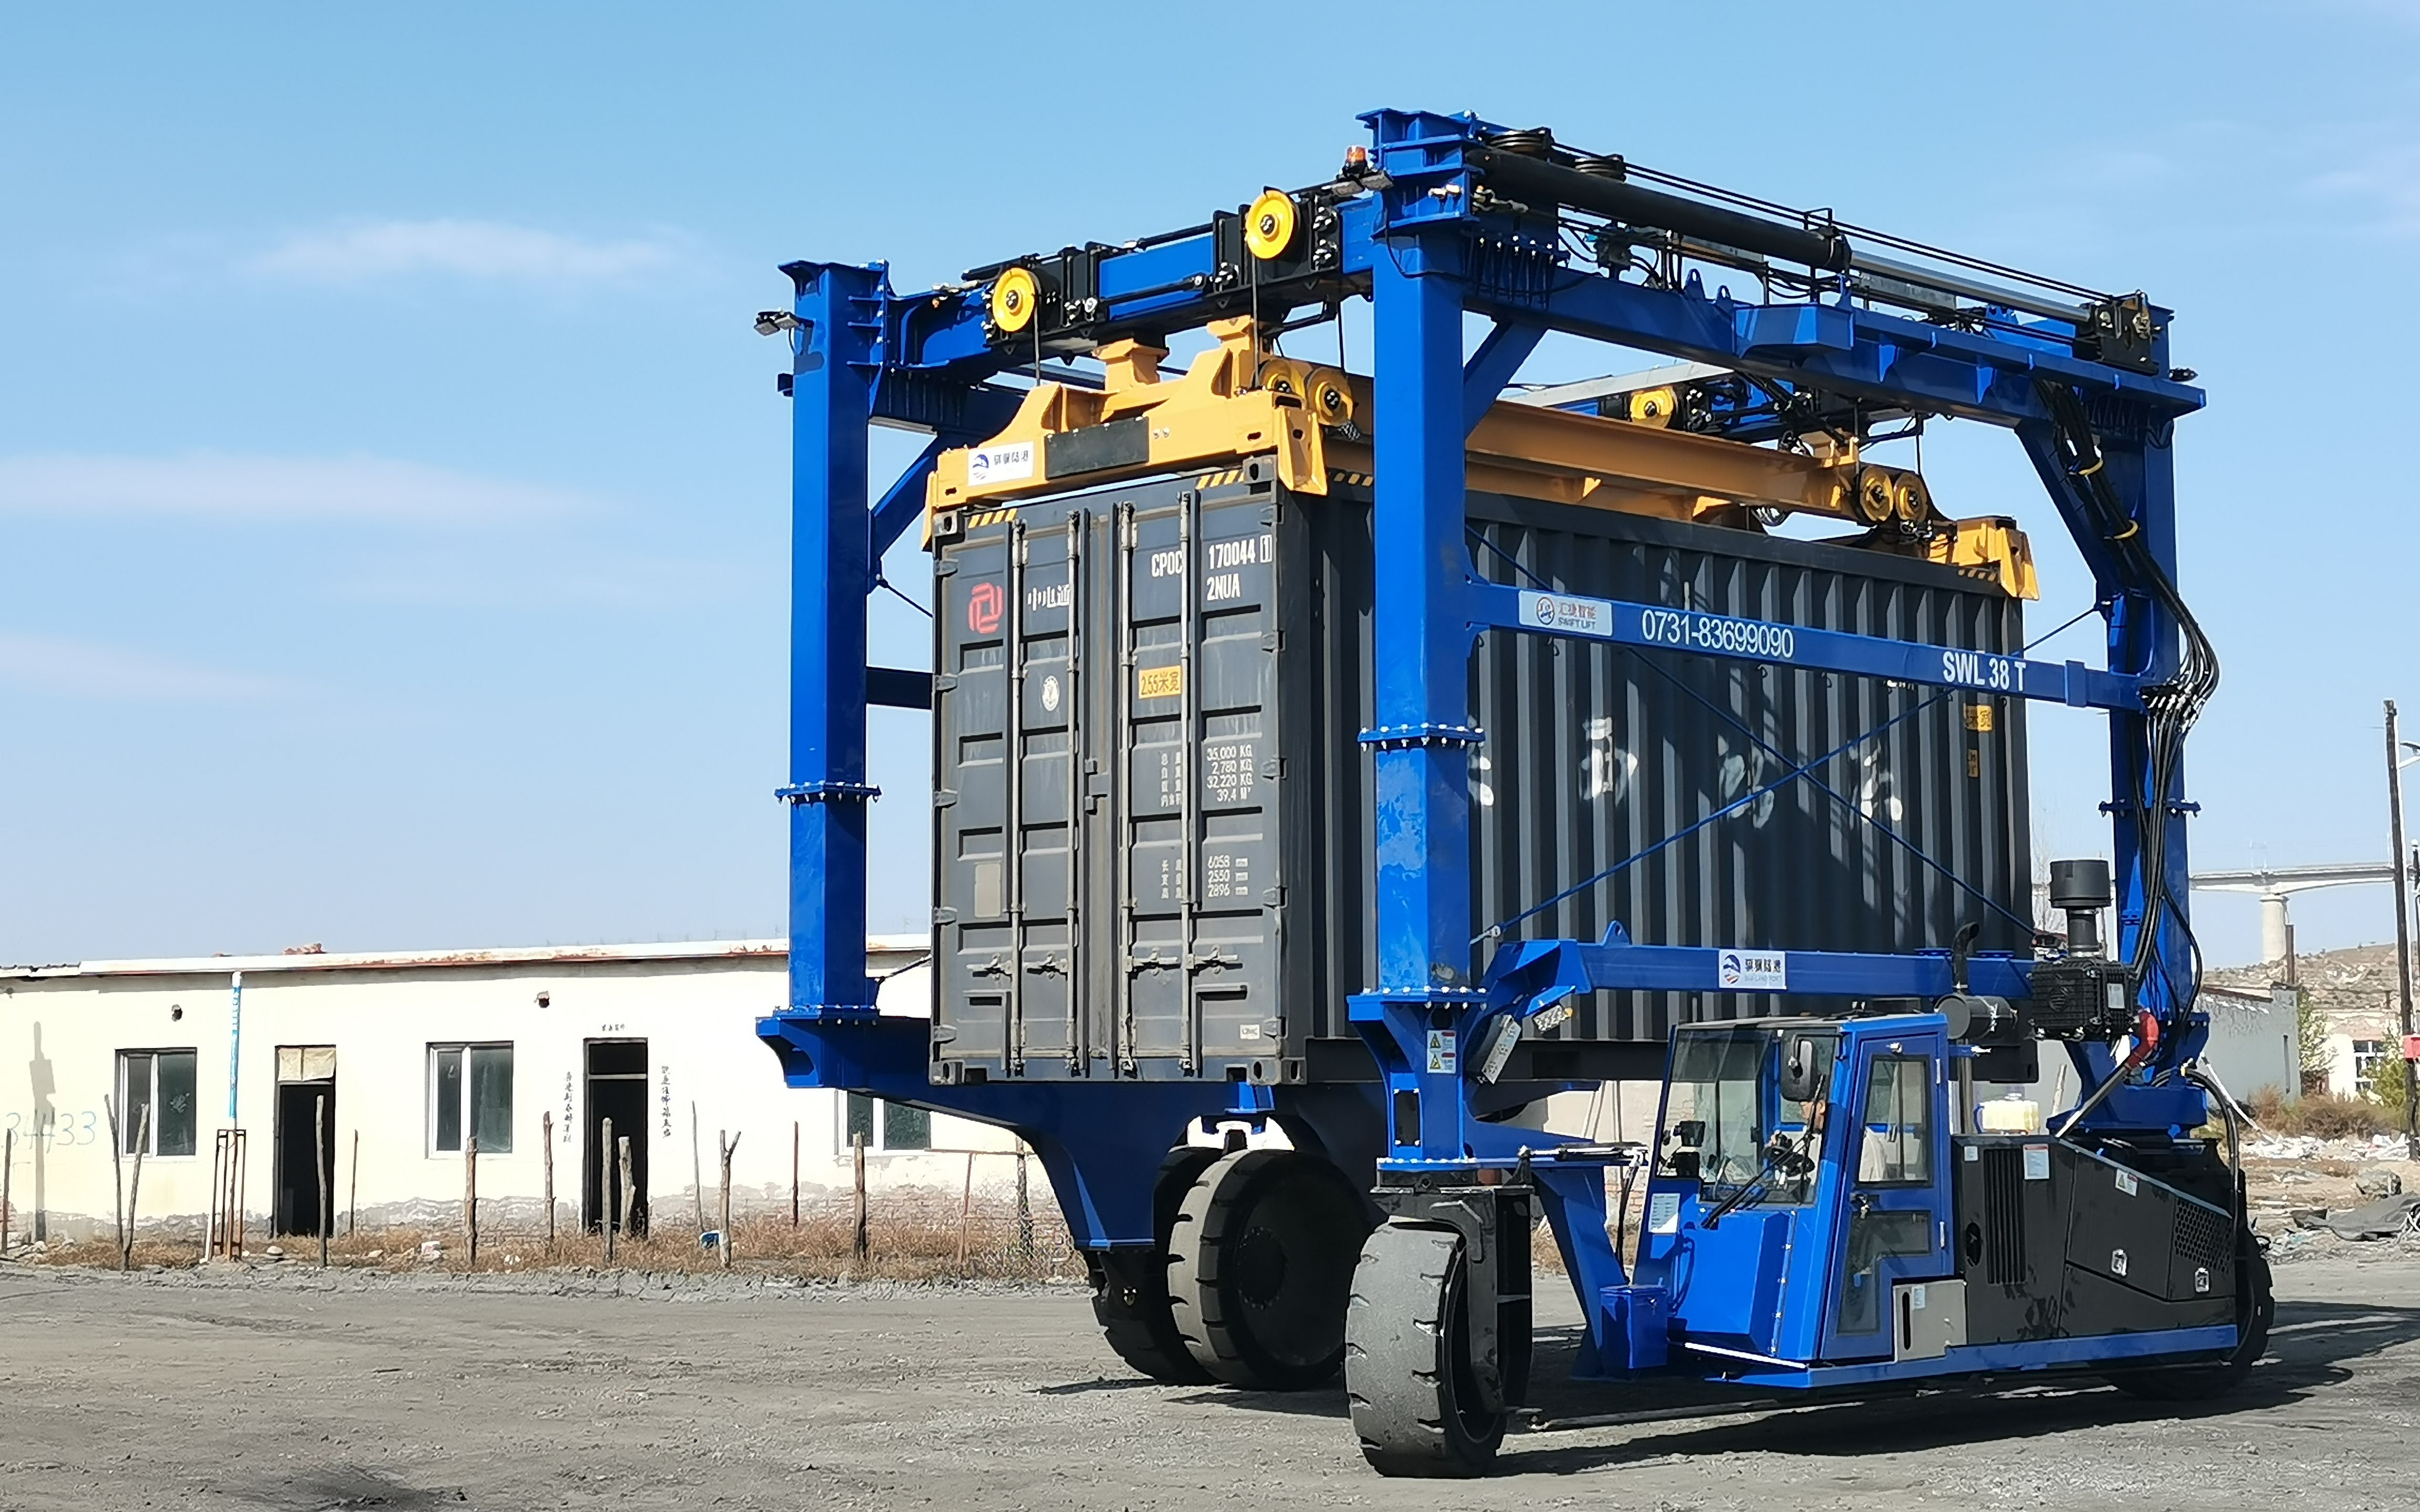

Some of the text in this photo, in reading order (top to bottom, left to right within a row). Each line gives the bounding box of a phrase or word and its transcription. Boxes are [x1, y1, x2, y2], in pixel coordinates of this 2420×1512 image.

[1152, 551, 1182, 577] CPOC
[1209, 539, 1256, 569] 170044
[1207, 573, 1240, 600] 2NUA
[1642, 610, 1794, 658] 0731-83699090
[1943, 652, 2026, 692] SWL 38 T
[1240, 744, 1253, 758] KG
[1240, 759, 1253, 772] KG
[1240, 772, 1254, 786] KG
